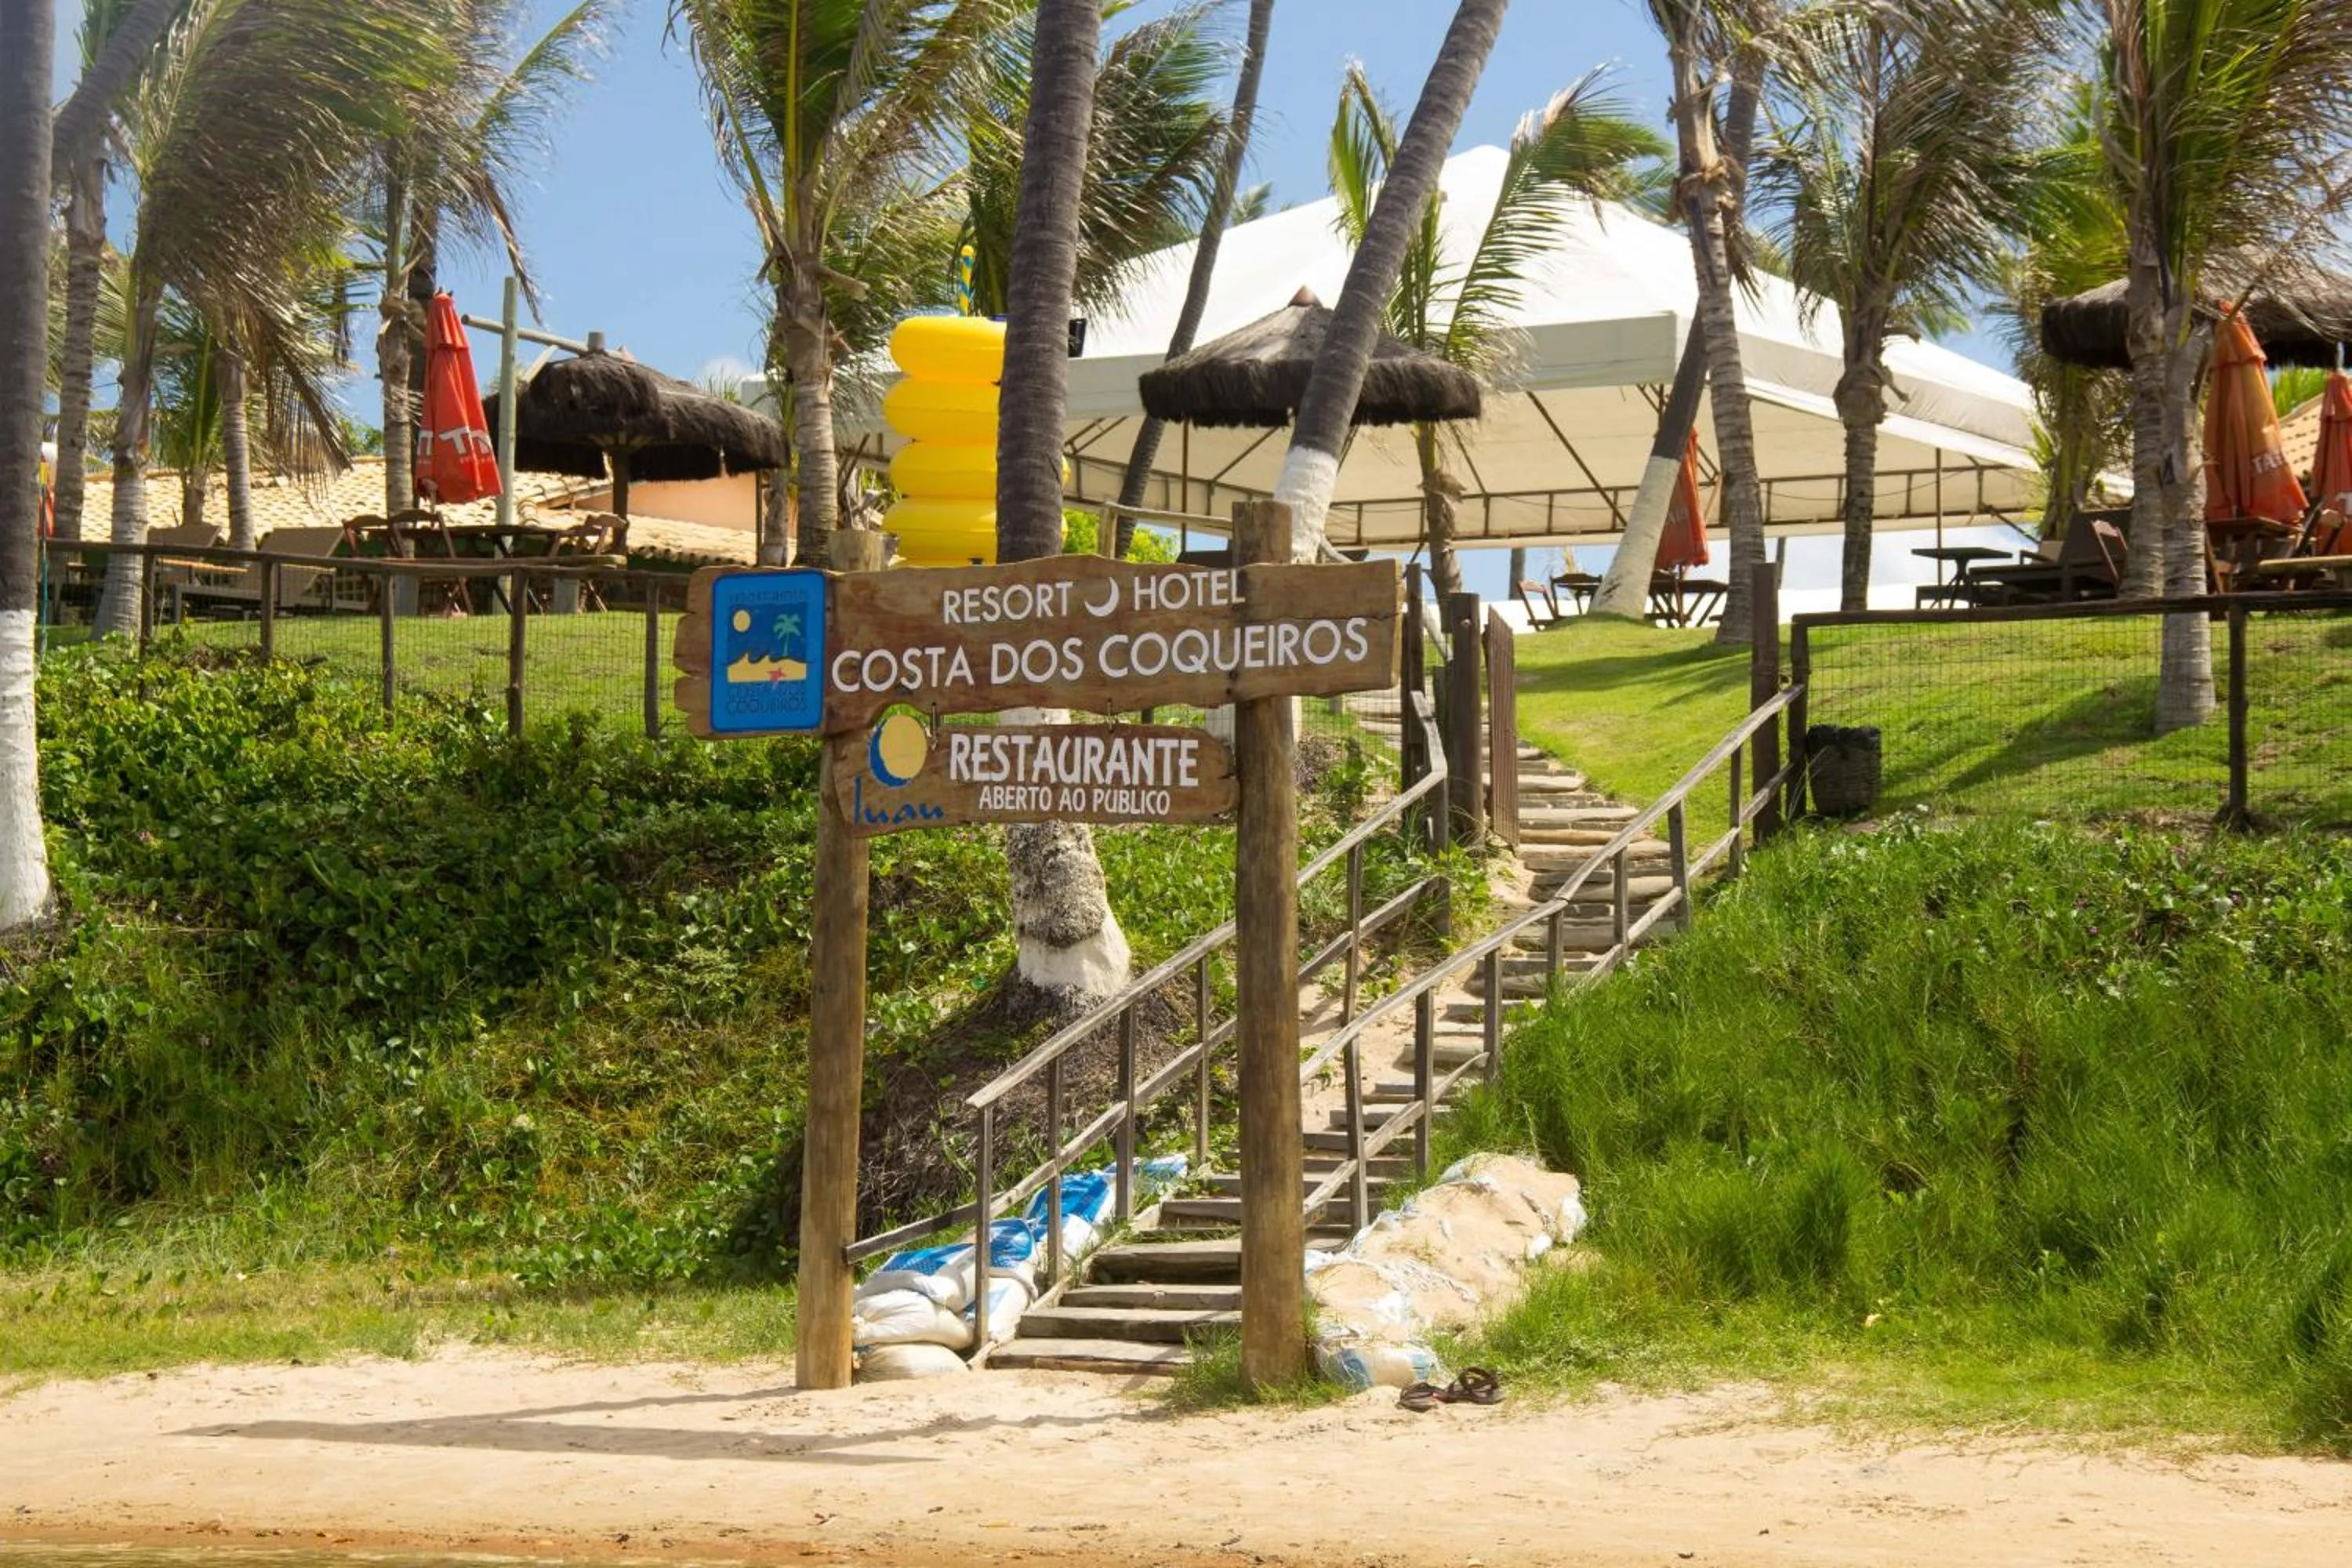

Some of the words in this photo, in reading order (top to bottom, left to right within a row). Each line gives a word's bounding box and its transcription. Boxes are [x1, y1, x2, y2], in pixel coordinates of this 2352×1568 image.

[943, 581, 1073, 625] RESORT
[1134, 568, 1247, 611] HOTEL
[831, 644, 975, 693] COSTA
[990, 637, 1084, 684] DOS
[1098, 616, 1369, 678] COQUEIROS
[949, 733, 1200, 787] RESTAURANTE
[978, 785, 1053, 811] ABERTO
[1058, 786, 1086, 813] AO
